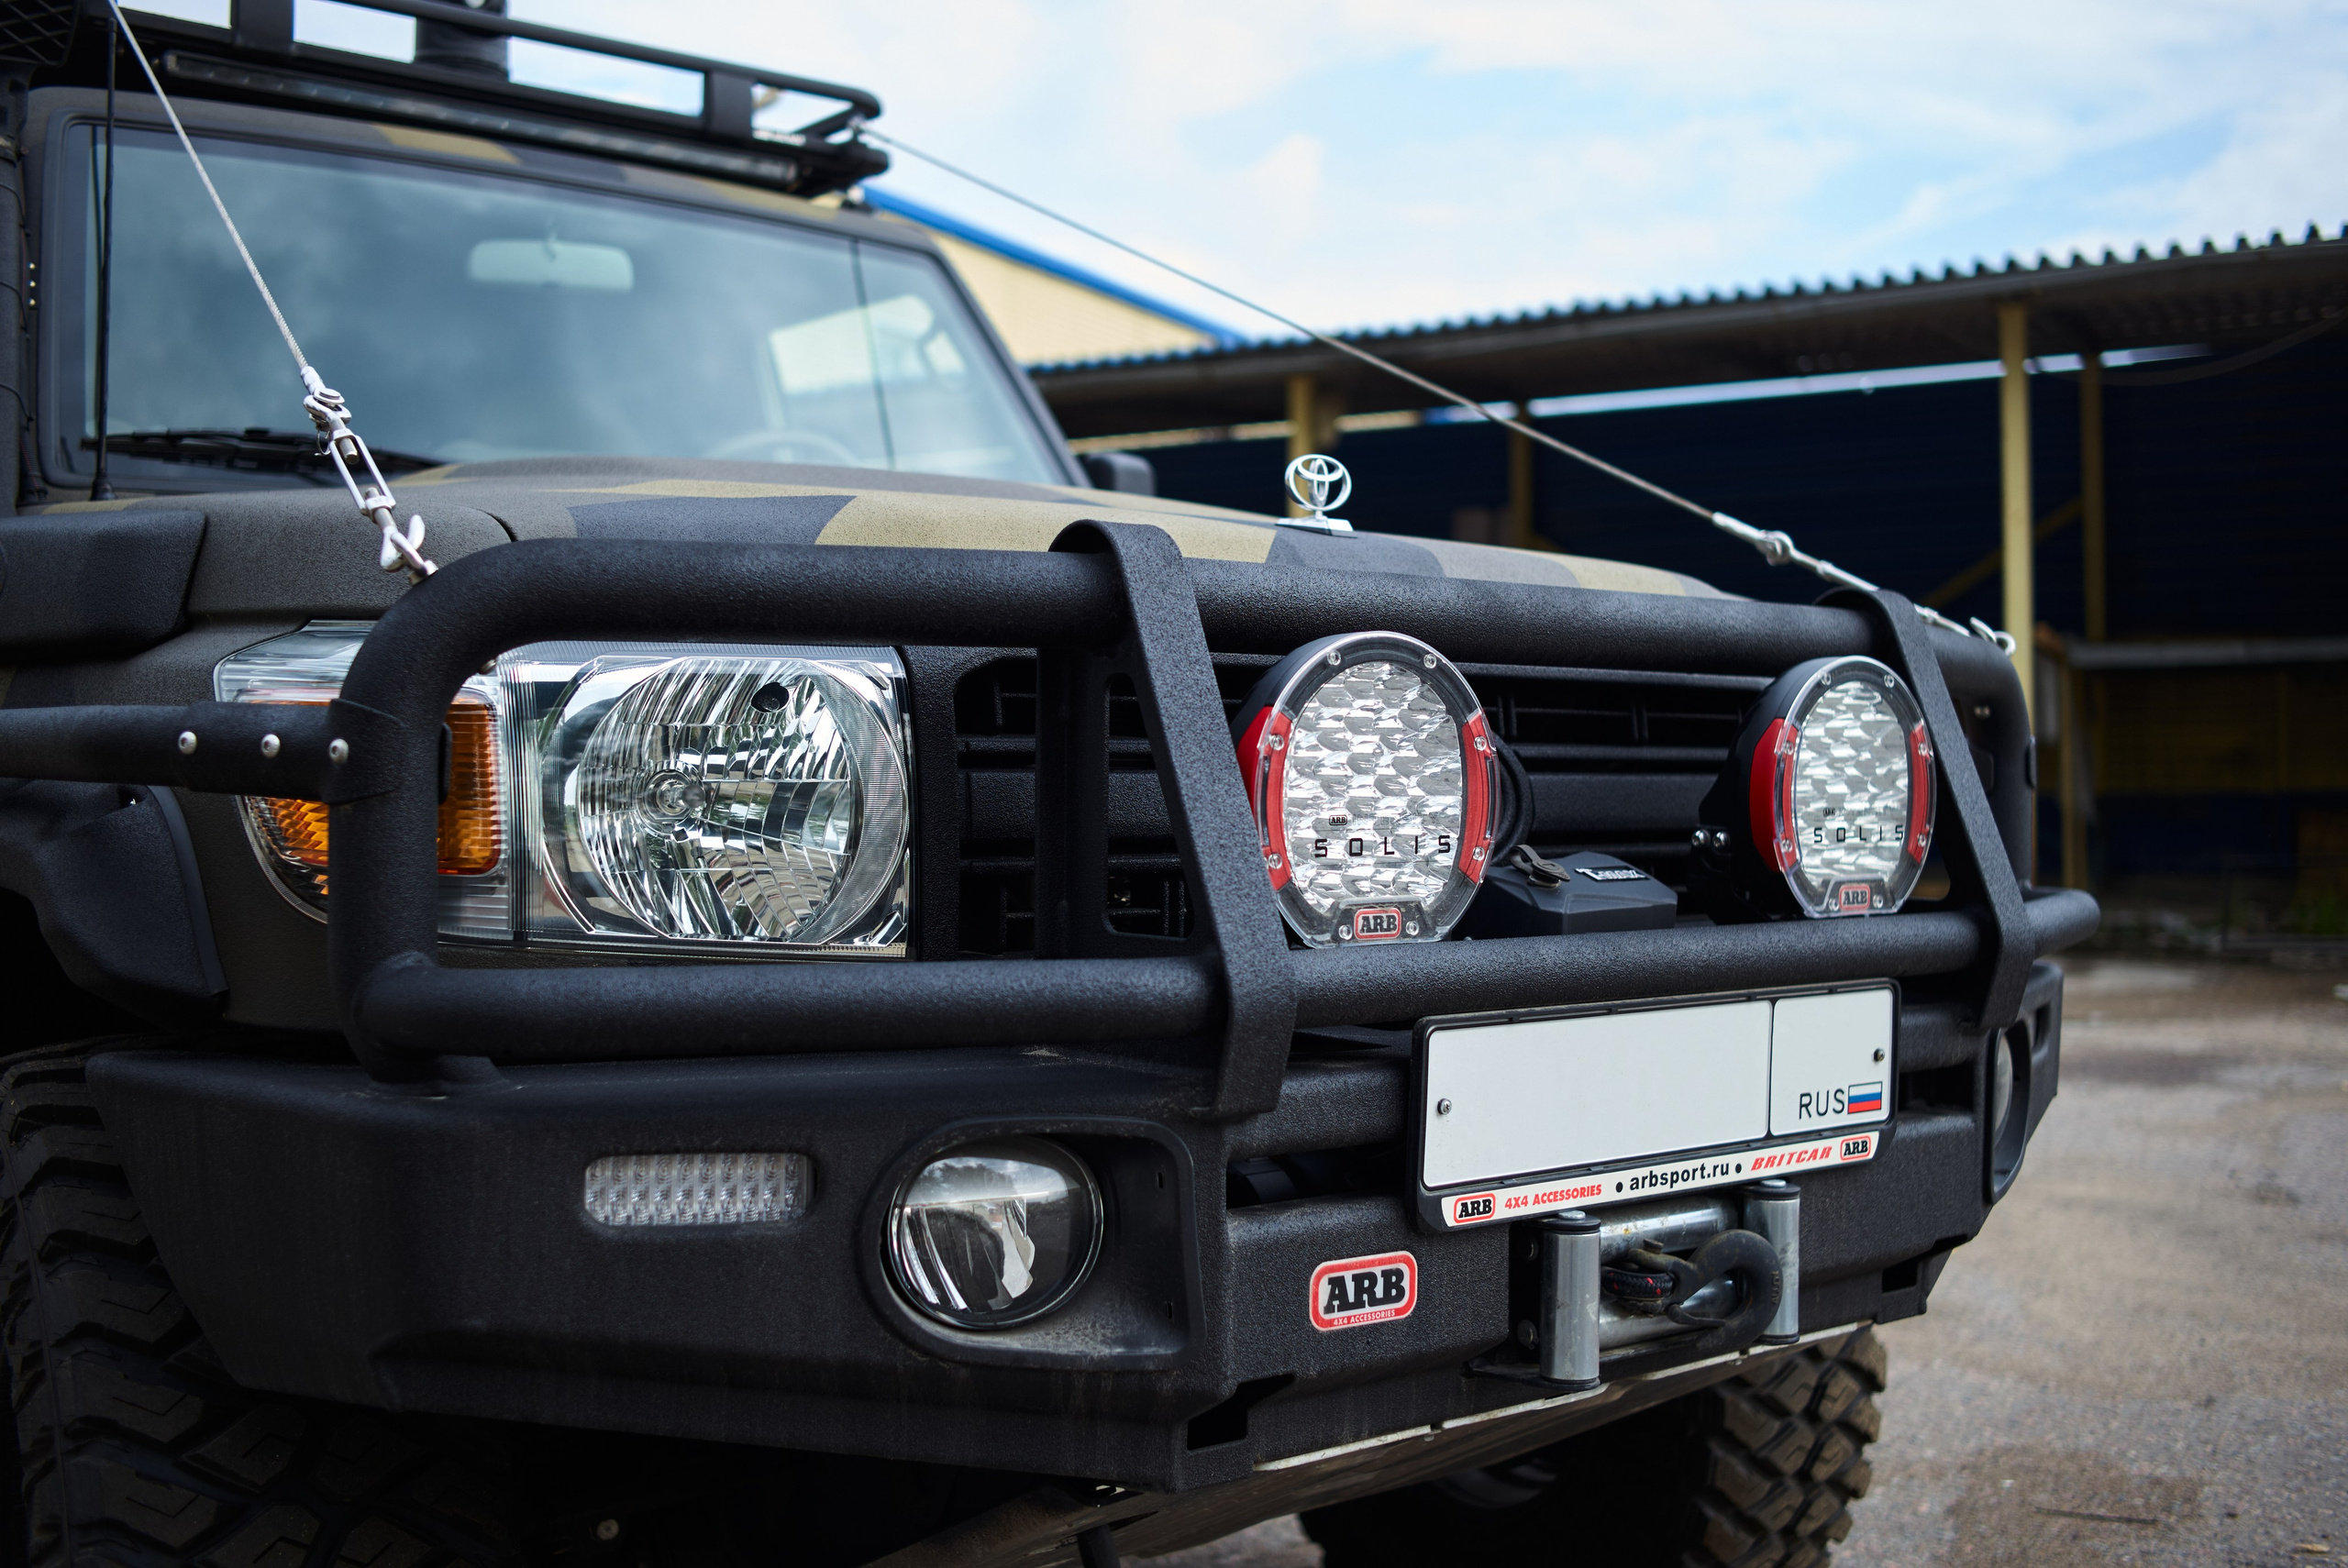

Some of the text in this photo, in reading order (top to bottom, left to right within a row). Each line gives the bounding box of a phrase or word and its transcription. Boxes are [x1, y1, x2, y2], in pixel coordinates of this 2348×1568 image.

[1330, 816, 1346, 824] ARB
[1813, 824, 1904, 843] SOLIS
[1314, 835, 1450, 857] SOLIS
[1843, 890, 1867, 906] ARB
[1359, 914, 1398, 933] ARB
[1799, 1088, 1845, 1120] RUS
[1458, 1139, 1868, 1219] ARB 4X4 ACCESSORIES arbsport.ru BRITCAR ARB
[1324, 1267, 1406, 1315] ARB
[1333, 1309, 1395, 1326] 4X4 ACCESSORIES
